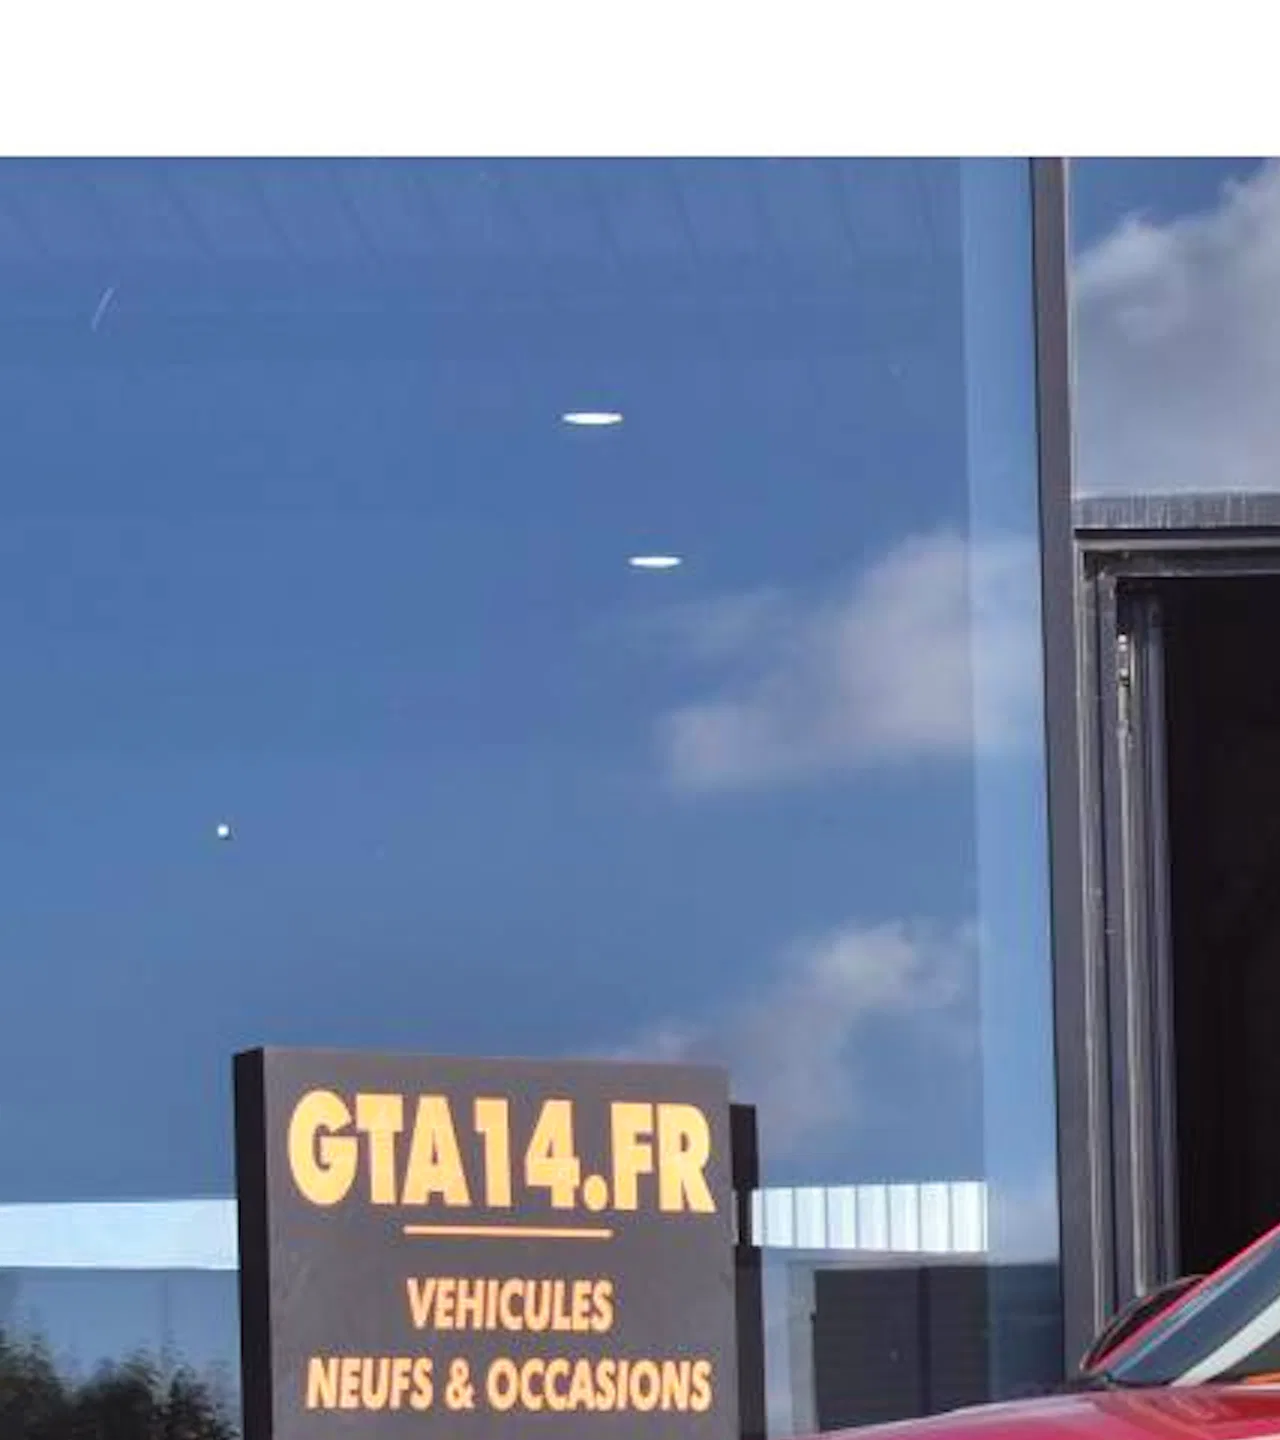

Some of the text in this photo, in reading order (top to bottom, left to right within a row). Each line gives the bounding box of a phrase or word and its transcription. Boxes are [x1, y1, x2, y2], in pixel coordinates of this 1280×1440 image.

[287, 1088, 716, 1214] GTA14.FR
[406, 1276, 614, 1334] VEHICULES
[305, 1355, 712, 1412] NEUFS & OCCASIONS
